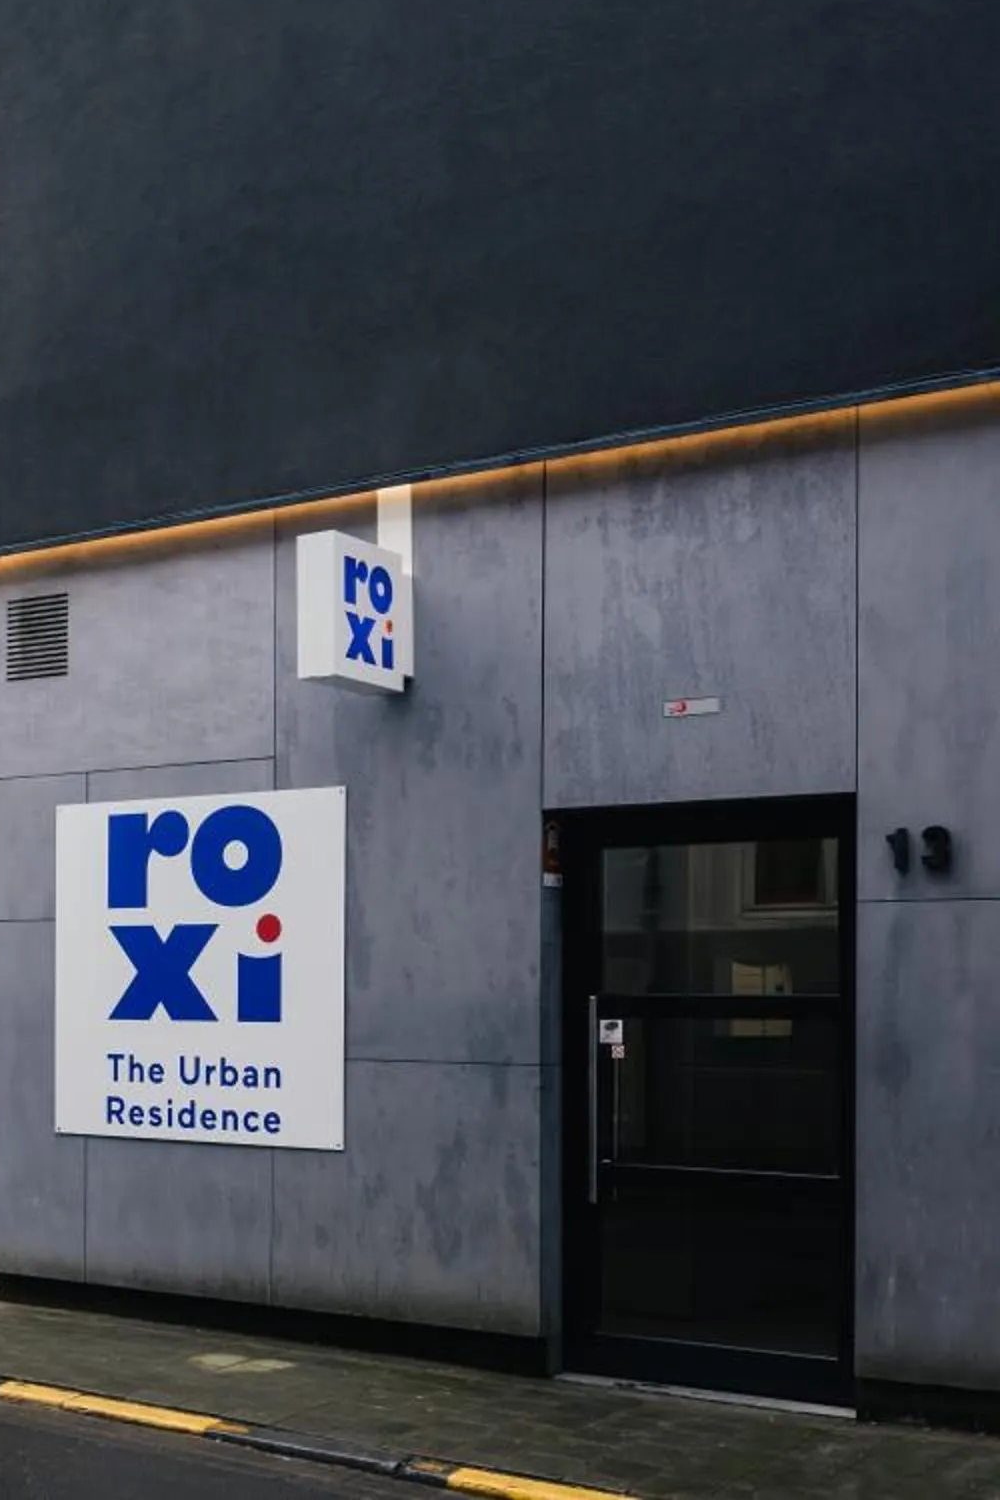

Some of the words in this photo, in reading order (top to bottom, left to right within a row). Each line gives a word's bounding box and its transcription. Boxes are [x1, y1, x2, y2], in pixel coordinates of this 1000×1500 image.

[344, 555, 393, 614] ro
[345, 612, 394, 670] xi
[107, 805, 282, 908] ro
[884, 825, 952, 874] 13
[108, 913, 283, 1023] xi
[107, 1053, 165, 1085] The
[178, 1057, 283, 1089] Urban
[105, 1095, 282, 1134] Residence
